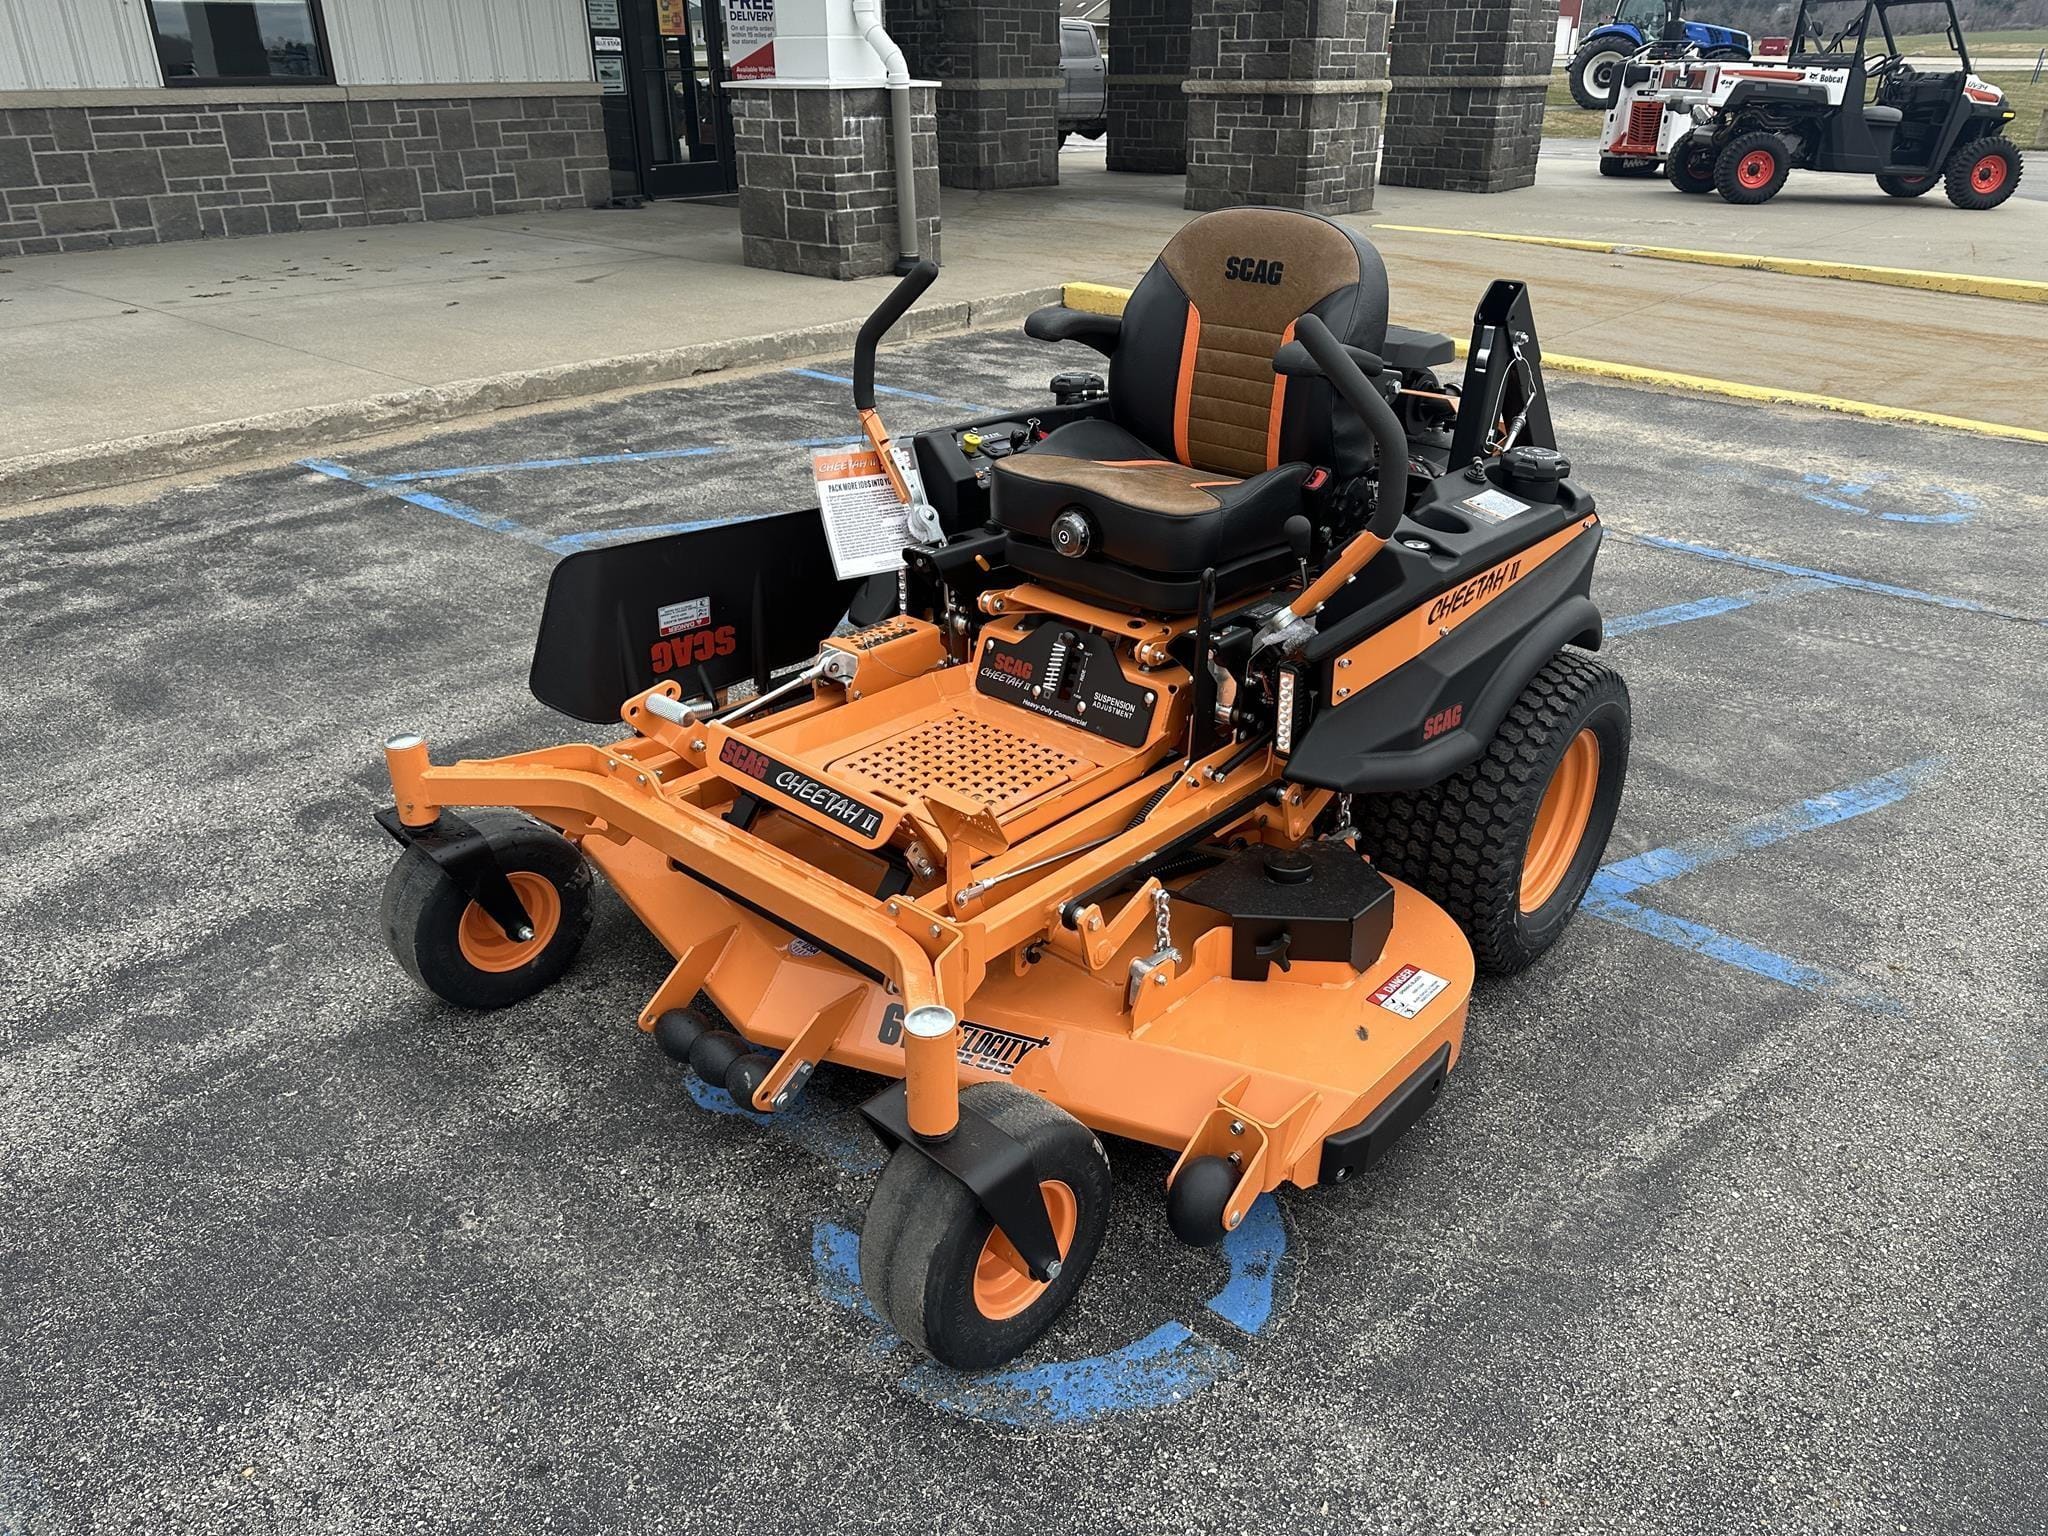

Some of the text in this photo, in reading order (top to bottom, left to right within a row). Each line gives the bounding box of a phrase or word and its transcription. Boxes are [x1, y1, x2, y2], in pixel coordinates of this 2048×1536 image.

[730, 11, 774, 21] DELIVERY
[1820, 74, 1843, 84] Bobcat
[1967, 80, 1988, 90] UV34
[1225, 256, 1284, 285] SCAG
[819, 459, 867, 473] CHEETAH
[828, 483, 842, 493] PACK
[842, 481, 858, 491] MORE
[858, 479, 872, 489] JOBS
[872, 478, 884, 487] INTO
[1428, 560, 1522, 625] CHEETAH II
[668, 621, 695, 633] DANGER
[651, 625, 736, 673] SCAG
[980, 667, 1025, 689] CHEETAH
[994, 653, 1033, 680] SCAG
[1022, 698, 1088, 727] Heavy-Duty Commercial
[1092, 700, 1133, 720] ADJUSTMENT
[1093, 691, 1136, 713] SUSPENSION
[1423, 703, 1463, 740] SCAG
[721, 740, 879, 832] SCAG CHEETAH II
[1383, 968, 1415, 993] DANGER
[877, 1003, 904, 1048] 6
